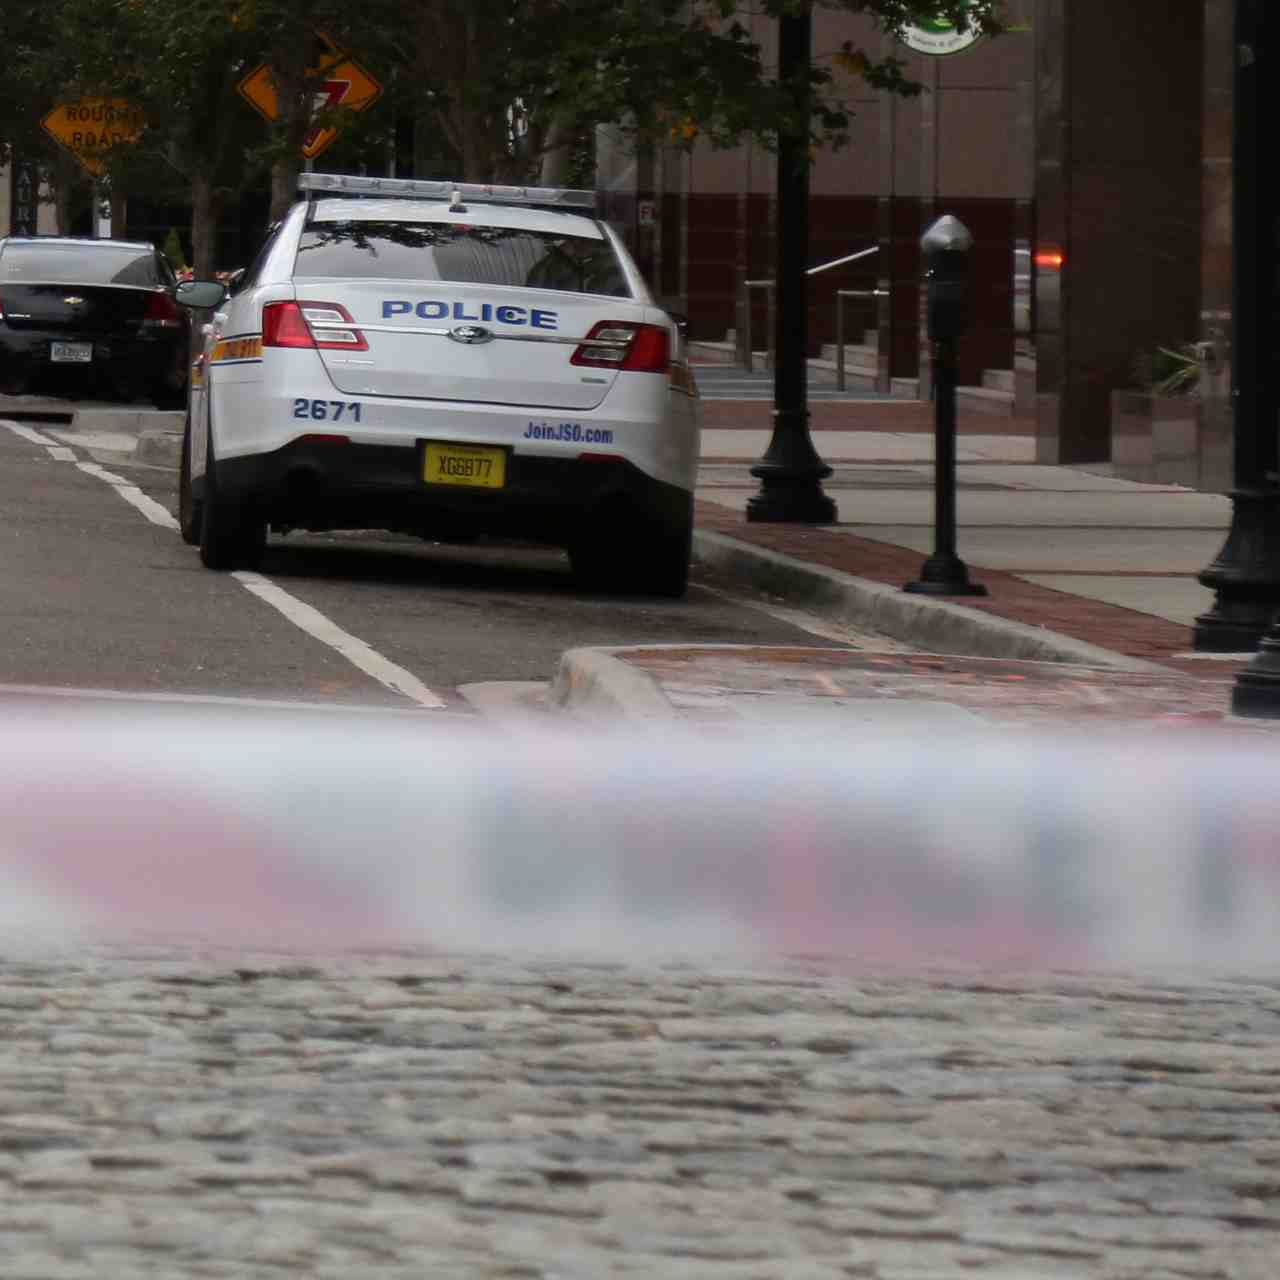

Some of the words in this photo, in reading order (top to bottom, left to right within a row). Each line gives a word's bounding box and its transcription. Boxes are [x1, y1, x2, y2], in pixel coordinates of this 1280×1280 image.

[382, 300, 558, 330] POLICE
[294, 398, 361, 423] 2671
[523, 422, 614, 444] JoinJSO.com
